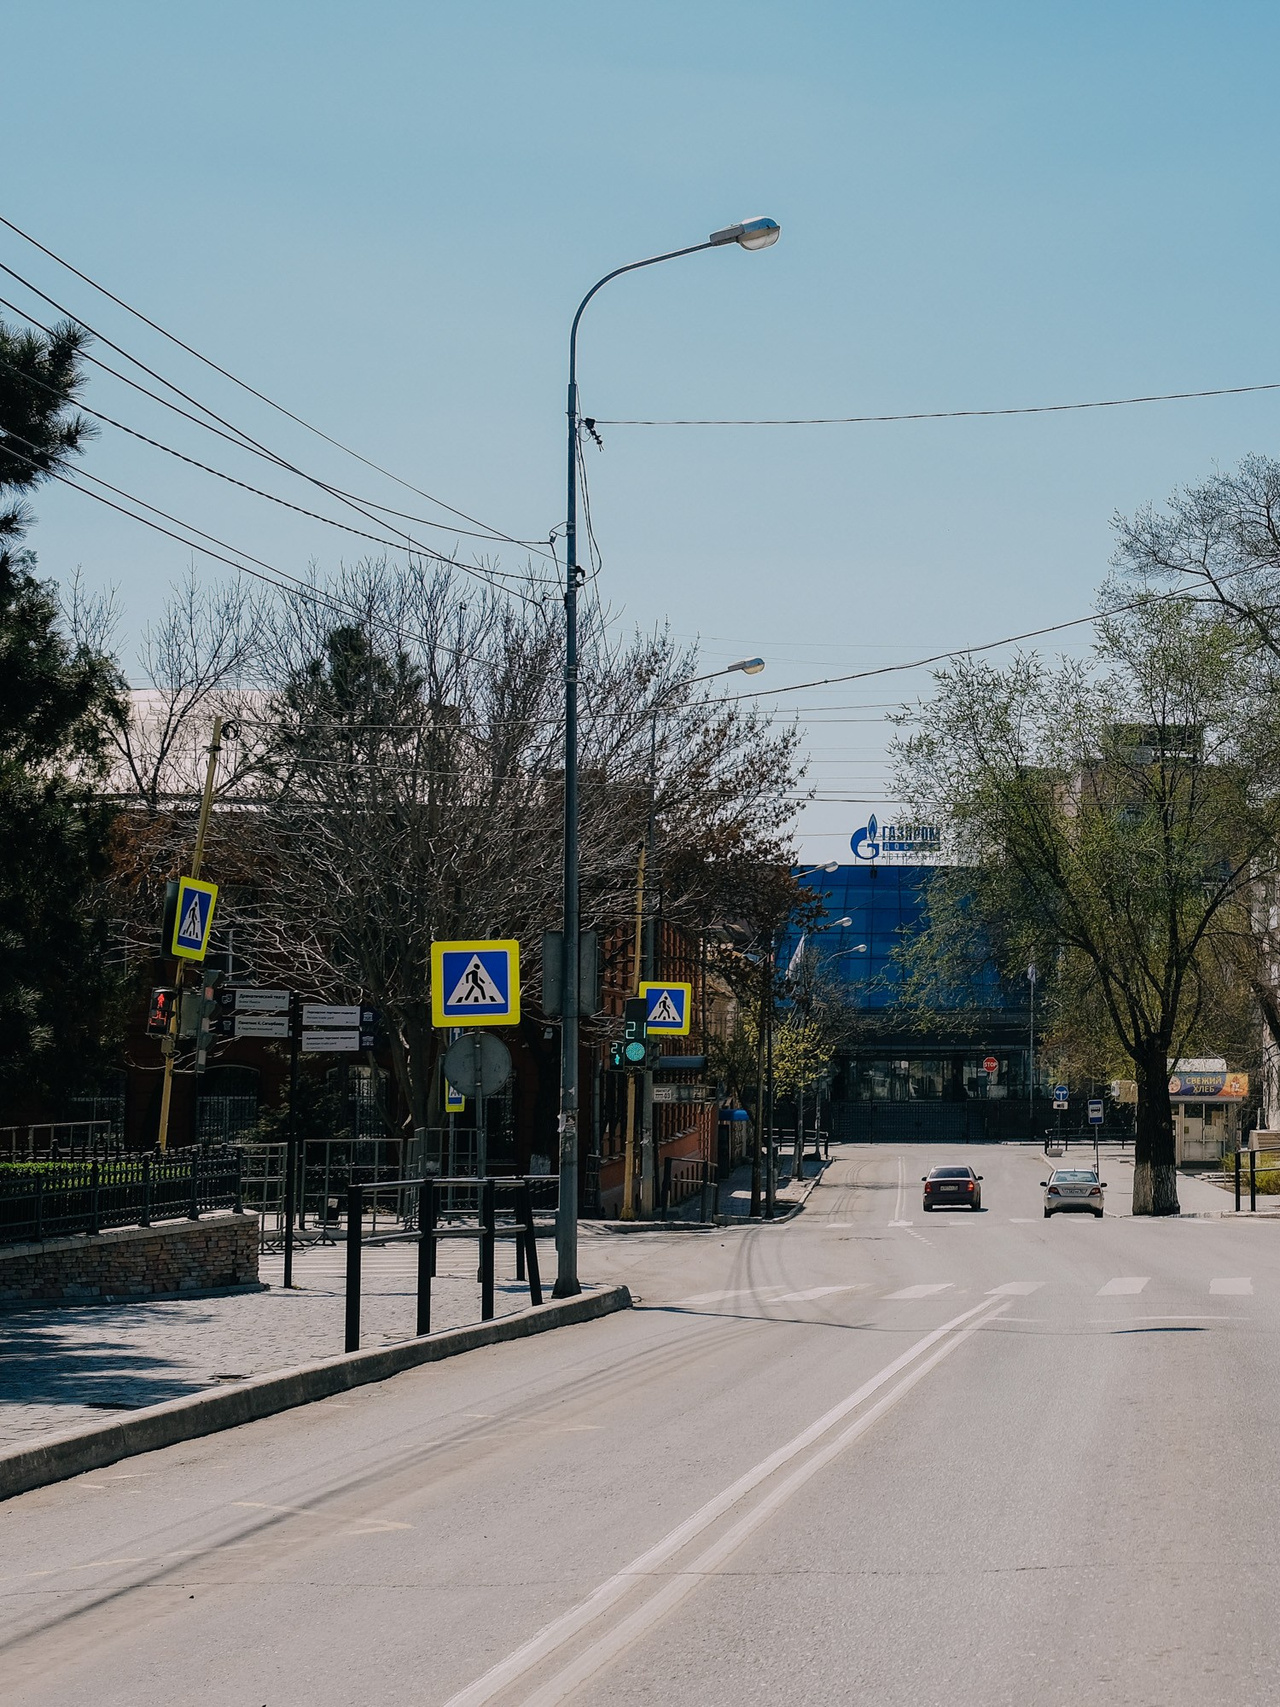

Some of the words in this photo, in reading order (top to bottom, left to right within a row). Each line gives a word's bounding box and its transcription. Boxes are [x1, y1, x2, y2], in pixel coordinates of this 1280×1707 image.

[882, 826, 940, 841] ГАЗПРОМ
[625, 1021, 647, 1039] 21
[611, 1043, 624, 1054] 21
[1185, 1076, 1222, 1085] СВЕЖИЙ
[1192, 1085, 1215, 1093] ХЛЕБ
